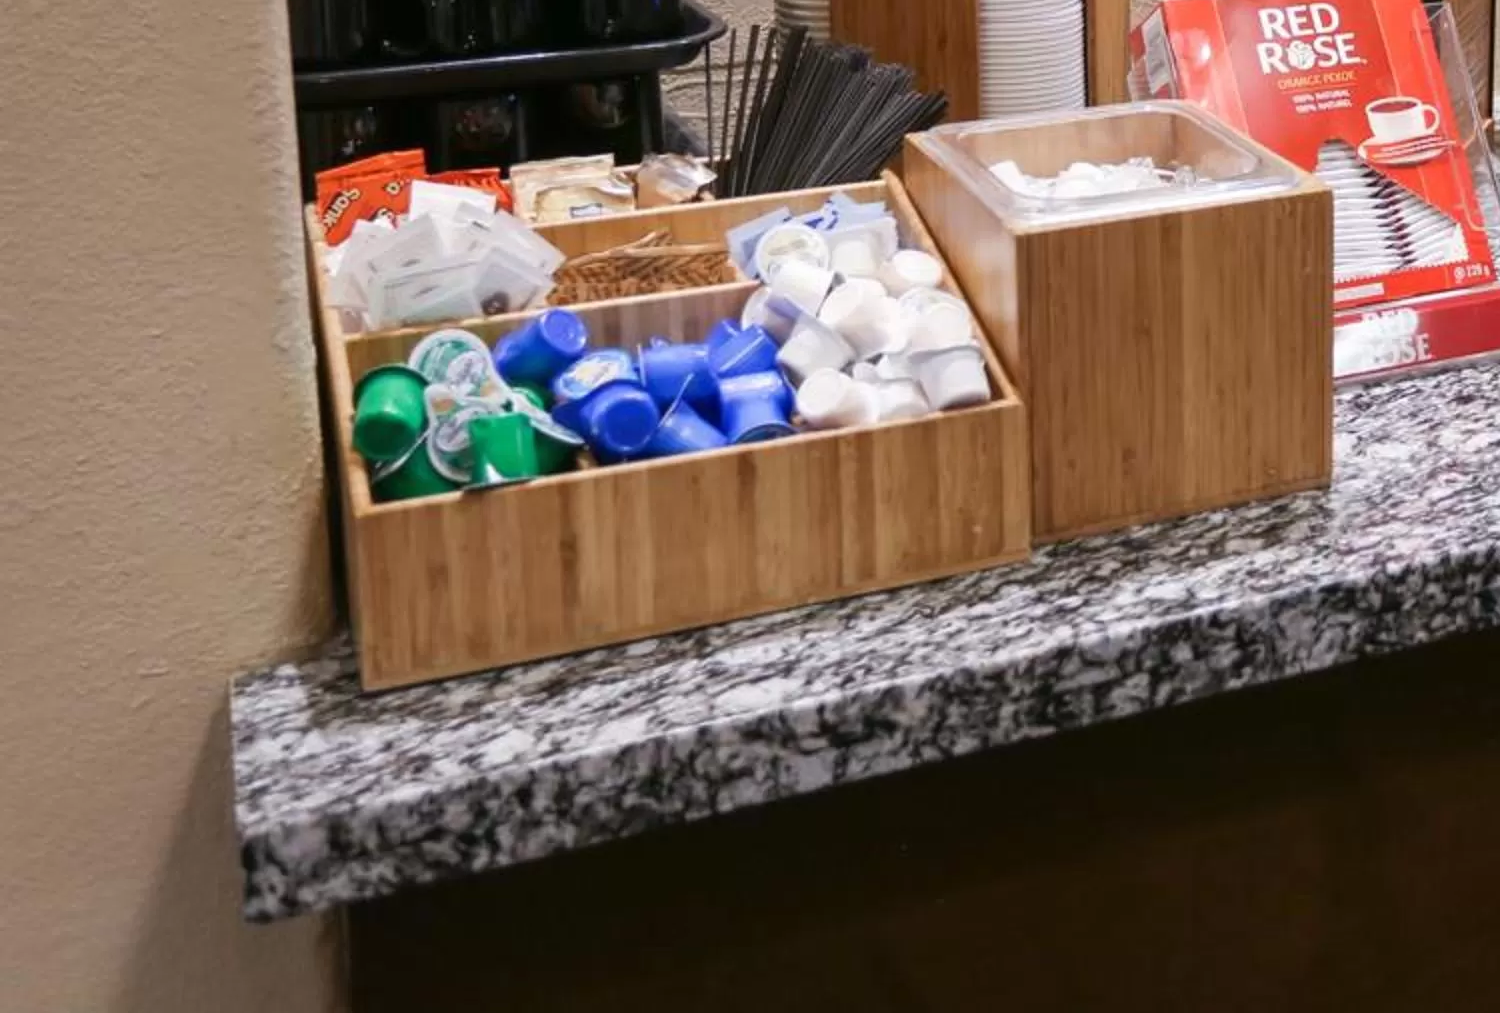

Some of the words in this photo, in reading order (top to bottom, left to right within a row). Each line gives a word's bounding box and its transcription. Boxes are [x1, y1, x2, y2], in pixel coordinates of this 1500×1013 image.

[1258, 2, 1340, 40] RED
[1256, 33, 1361, 75] ROSE
[322, 187, 361, 230] Sank
